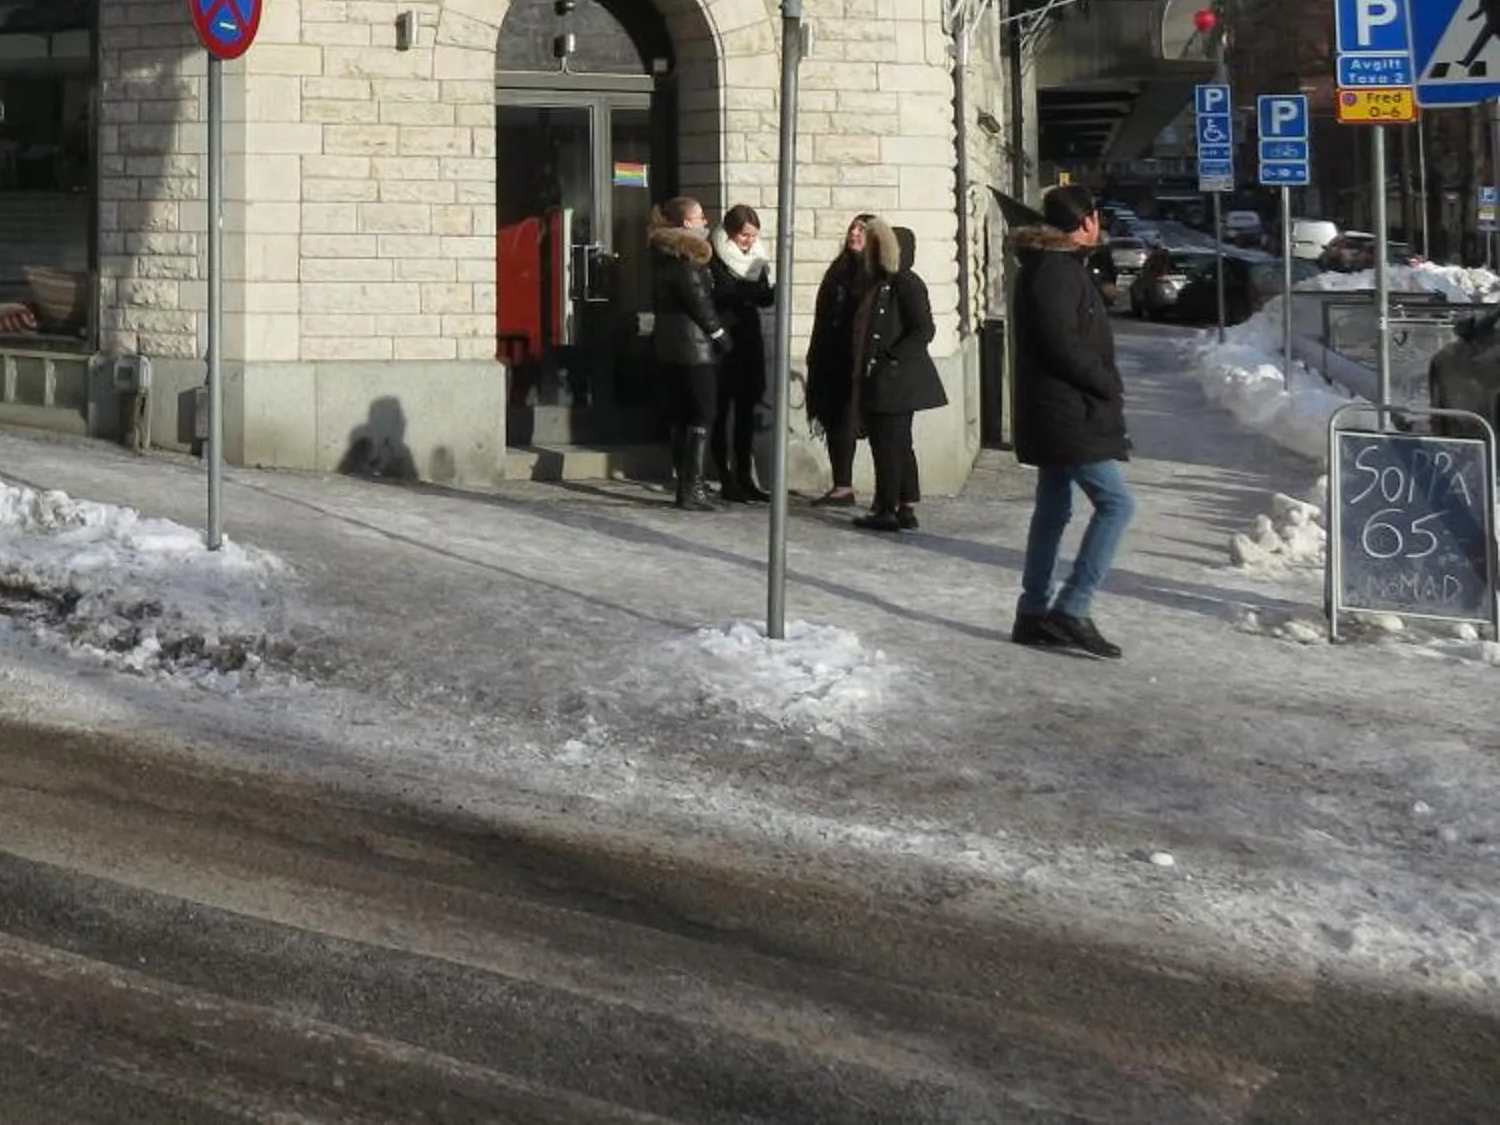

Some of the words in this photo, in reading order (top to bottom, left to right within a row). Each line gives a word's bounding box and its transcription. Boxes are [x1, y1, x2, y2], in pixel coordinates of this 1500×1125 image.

[1350, 58, 1403, 72] Avgift
[1348, 73, 1389, 84] Taxa
[1395, 73, 1405, 84] 2
[1205, 88, 1223, 112] P
[1366, 92, 1402, 104] Fred
[1271, 100, 1299, 134] P
[1369, 105, 1401, 118] 0-6
[1350, 444, 1472, 507] SOPPA
[1363, 507, 1449, 558] 65
